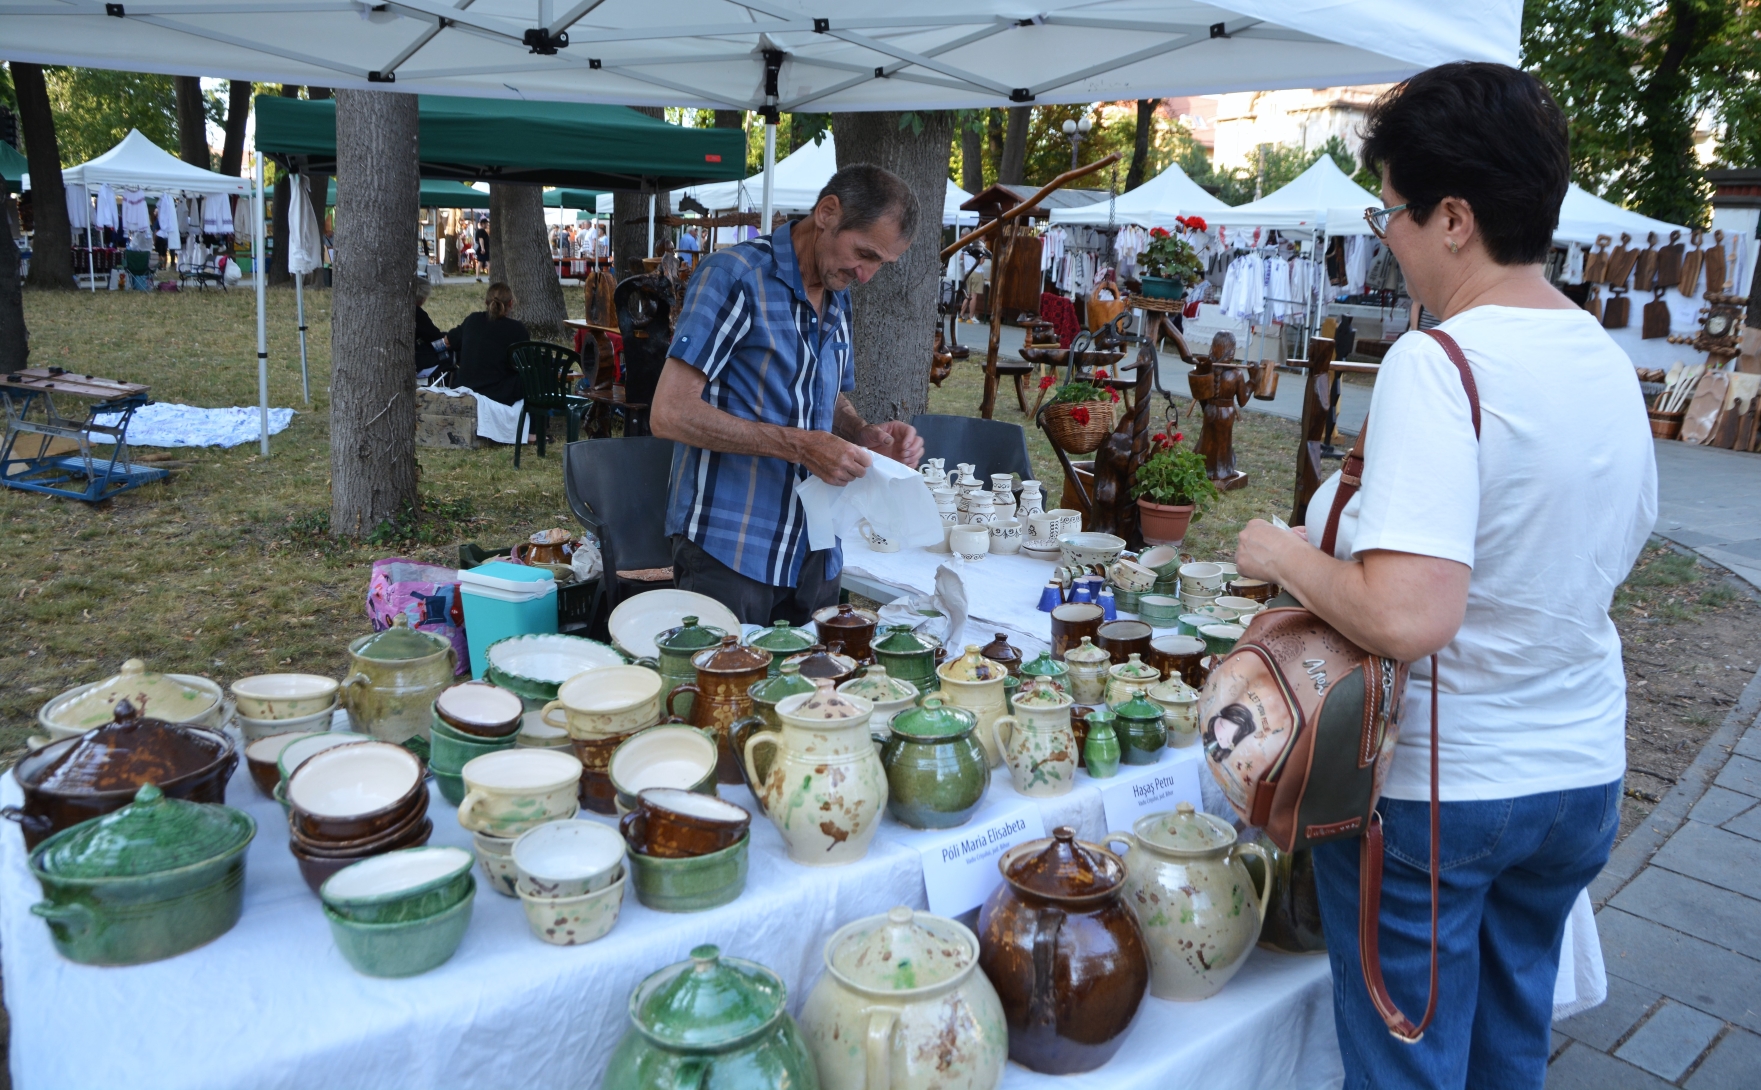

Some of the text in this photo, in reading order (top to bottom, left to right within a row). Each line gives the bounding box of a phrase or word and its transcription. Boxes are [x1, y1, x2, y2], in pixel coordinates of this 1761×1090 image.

[1154, 776, 1175, 790] Petru
[941, 819, 1026, 863] Póli Maria Elisabeta
